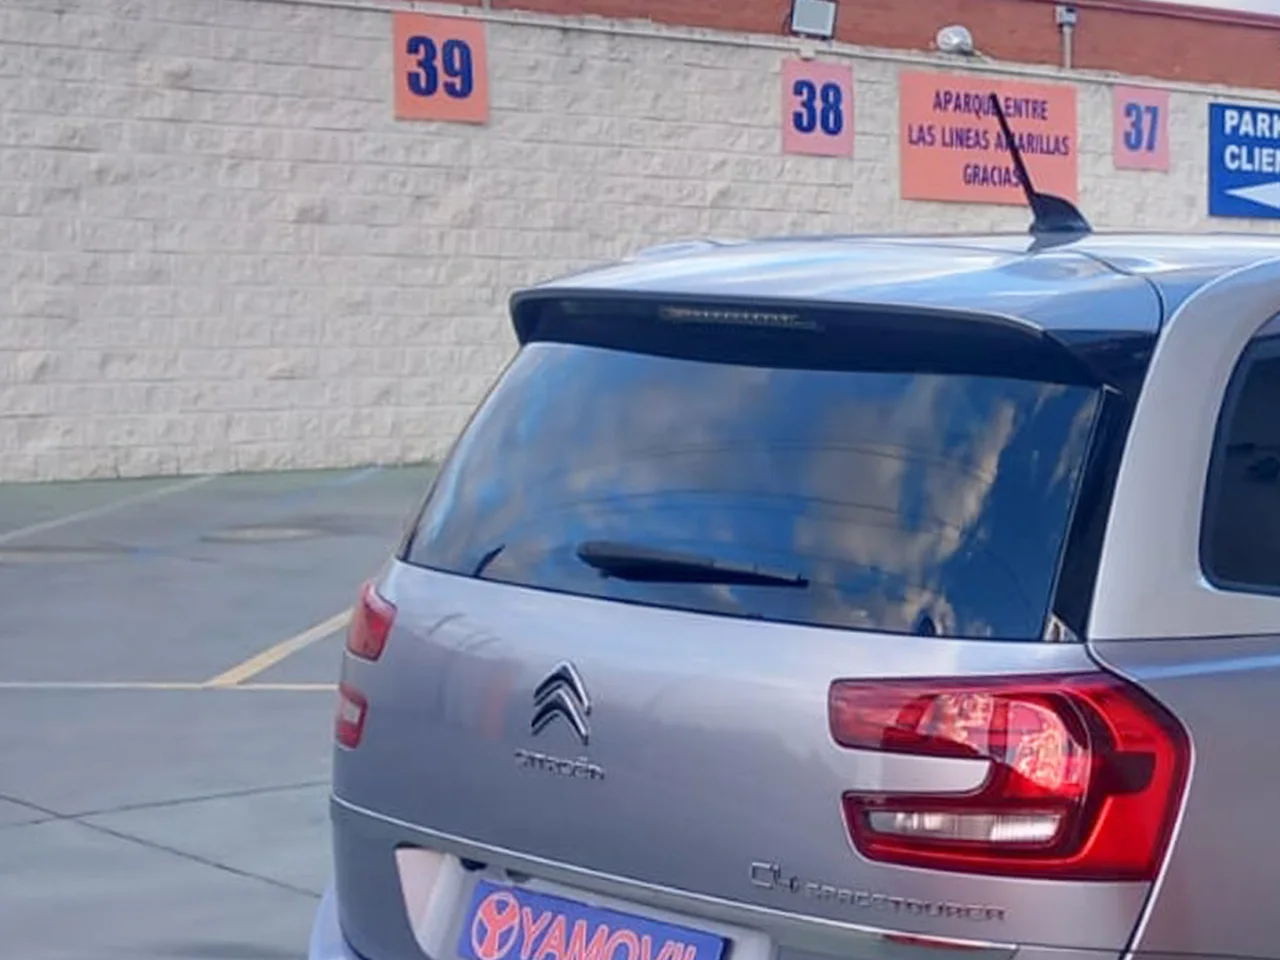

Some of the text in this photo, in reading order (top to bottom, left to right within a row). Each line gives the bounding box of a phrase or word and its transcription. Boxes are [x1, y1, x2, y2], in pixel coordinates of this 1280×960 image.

[406, 35, 475, 100] 39
[792, 79, 845, 137] 38
[1003, 96, 1048, 120] ENTRE
[1123, 102, 1160, 153] 37
[908, 123, 936, 146] LAS
[941, 127, 990, 150] LINEAS
[963, 163, 1022, 188] GRACIAS
